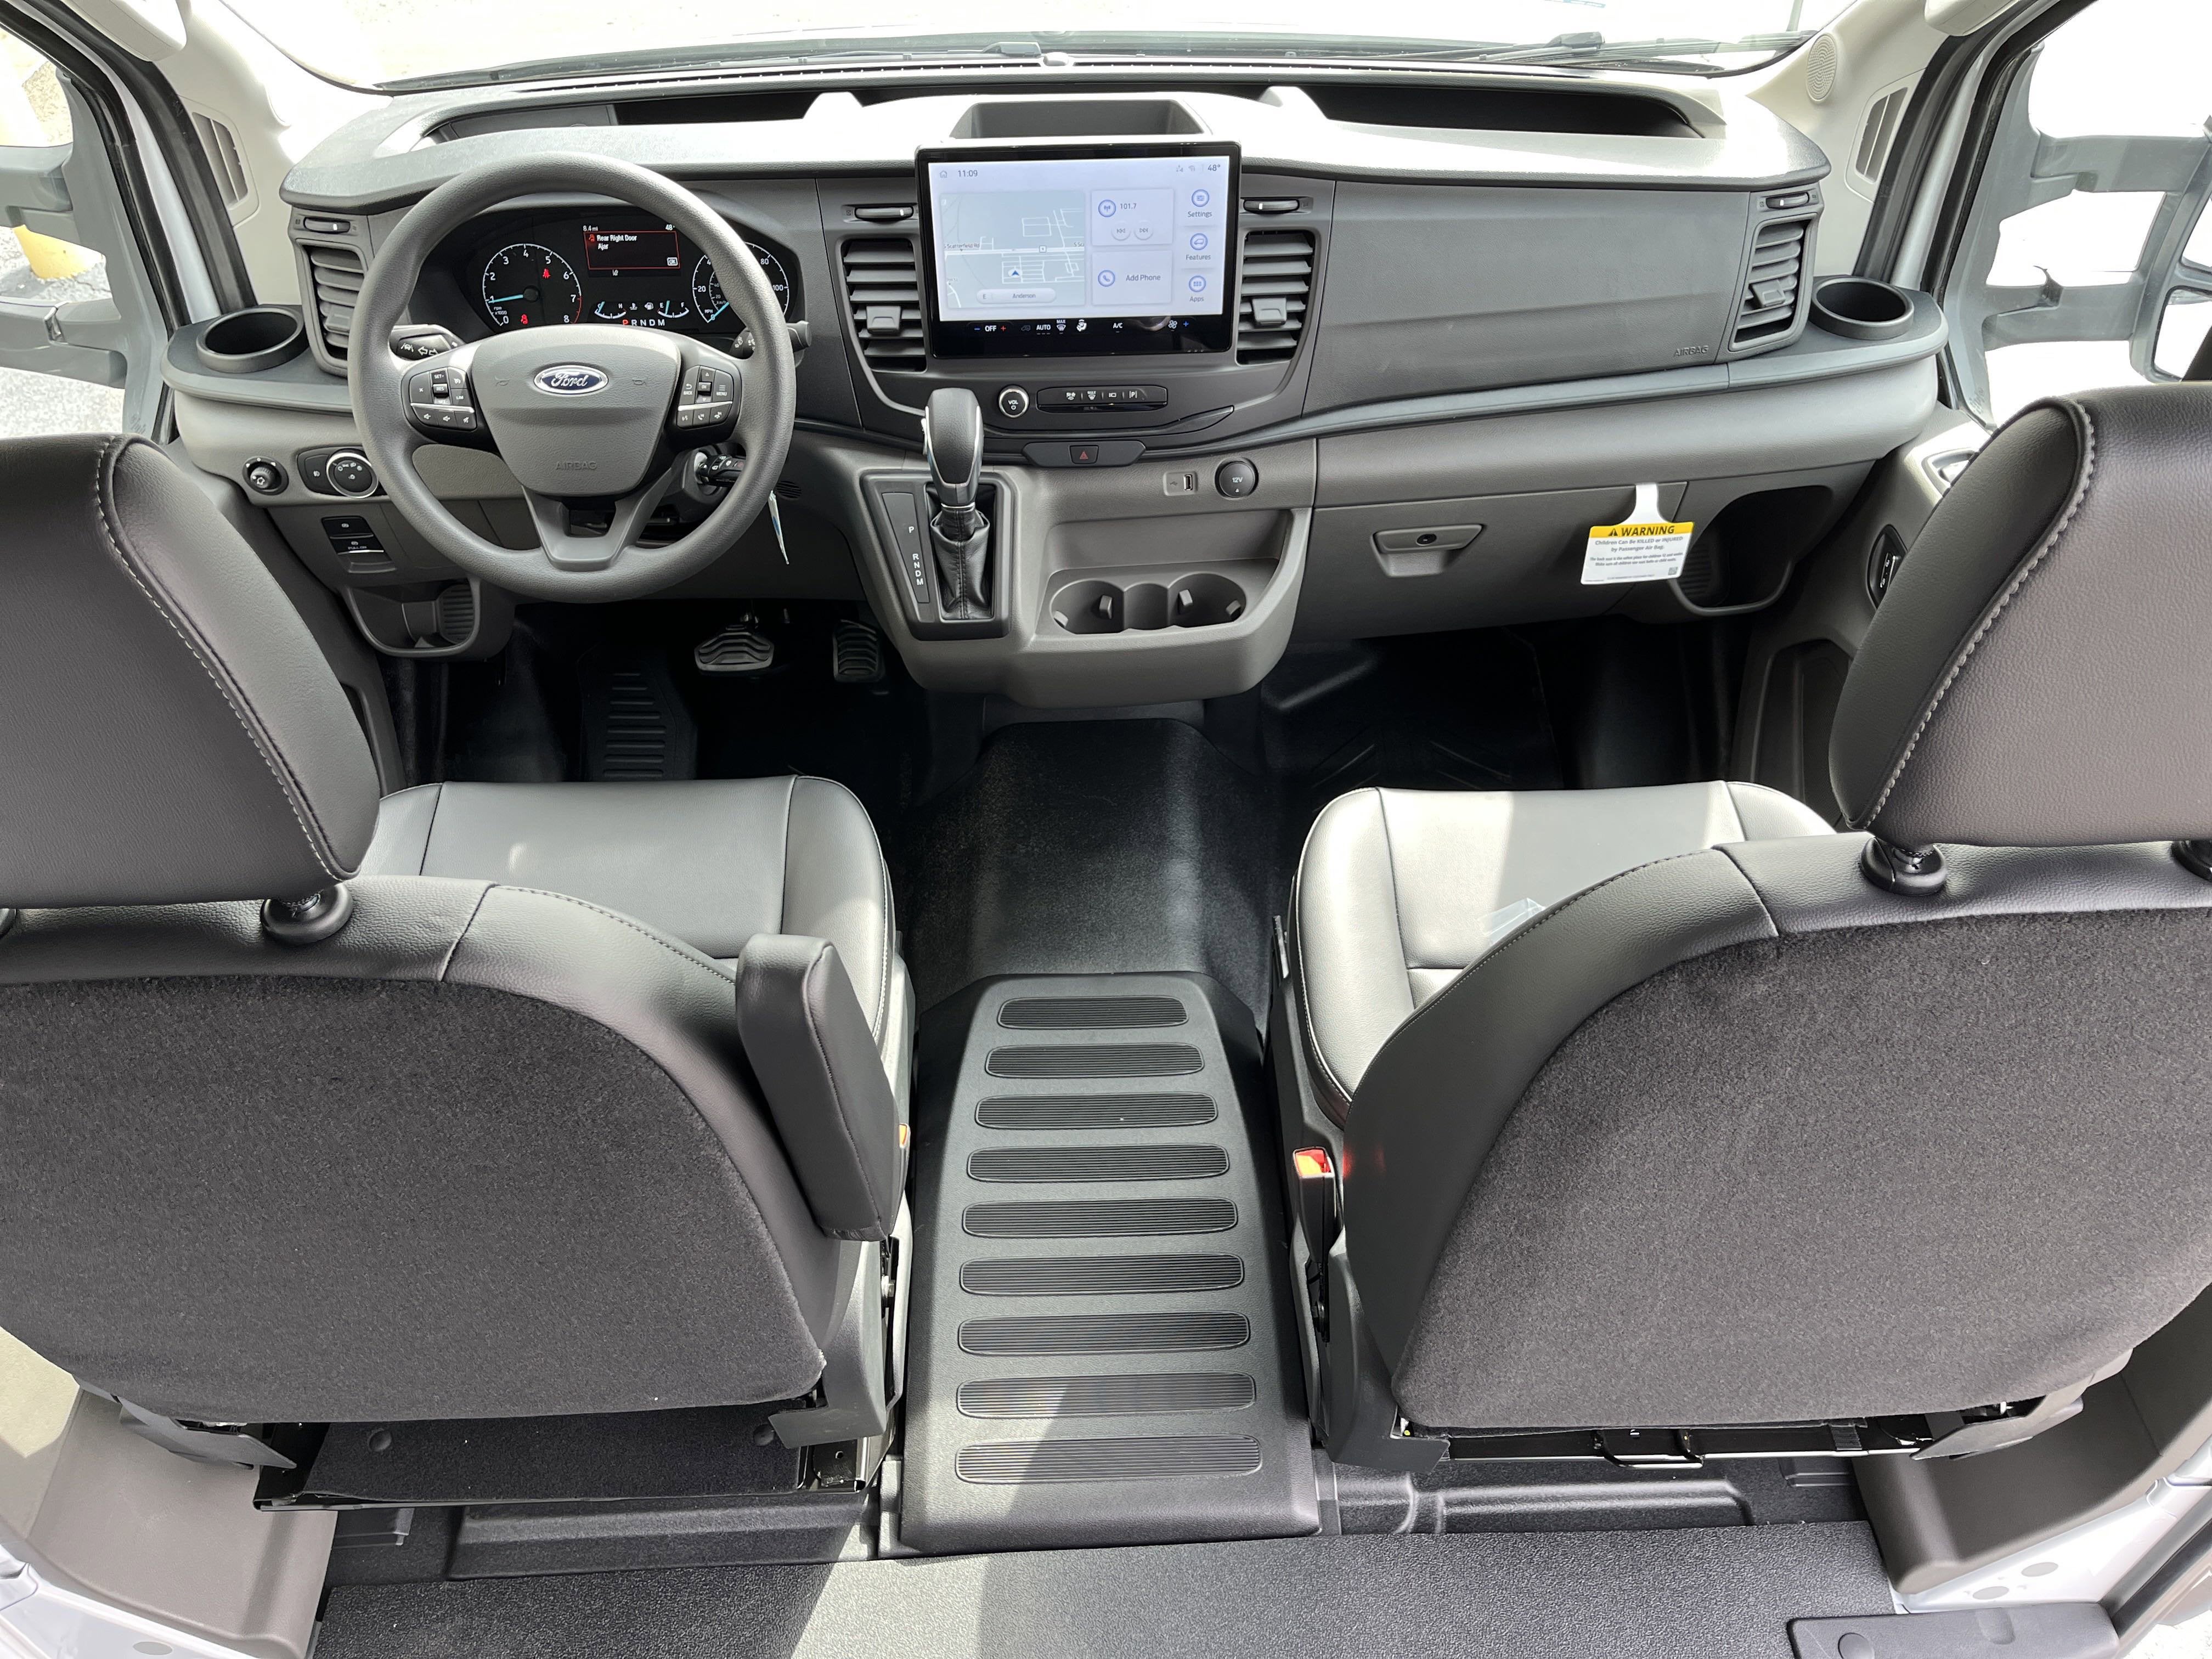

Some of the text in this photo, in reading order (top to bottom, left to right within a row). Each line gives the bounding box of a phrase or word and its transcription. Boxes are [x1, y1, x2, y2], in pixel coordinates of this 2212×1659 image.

[523, 249, 529, 258] 4
[503, 256, 509, 265] 3
[545, 256, 551, 264] 5
[489, 272, 496, 281] 2
[563, 272, 569, 280] 6
[570, 294, 576, 303] 7
[503, 315, 509, 324] 0
[563, 315, 569, 323] 8
[1674, 345, 1709, 357] AIRBAG
[551, 371, 589, 387] Ford
[556, 461, 597, 470] AIRBAG
[1621, 525, 1675, 537] WARNING
